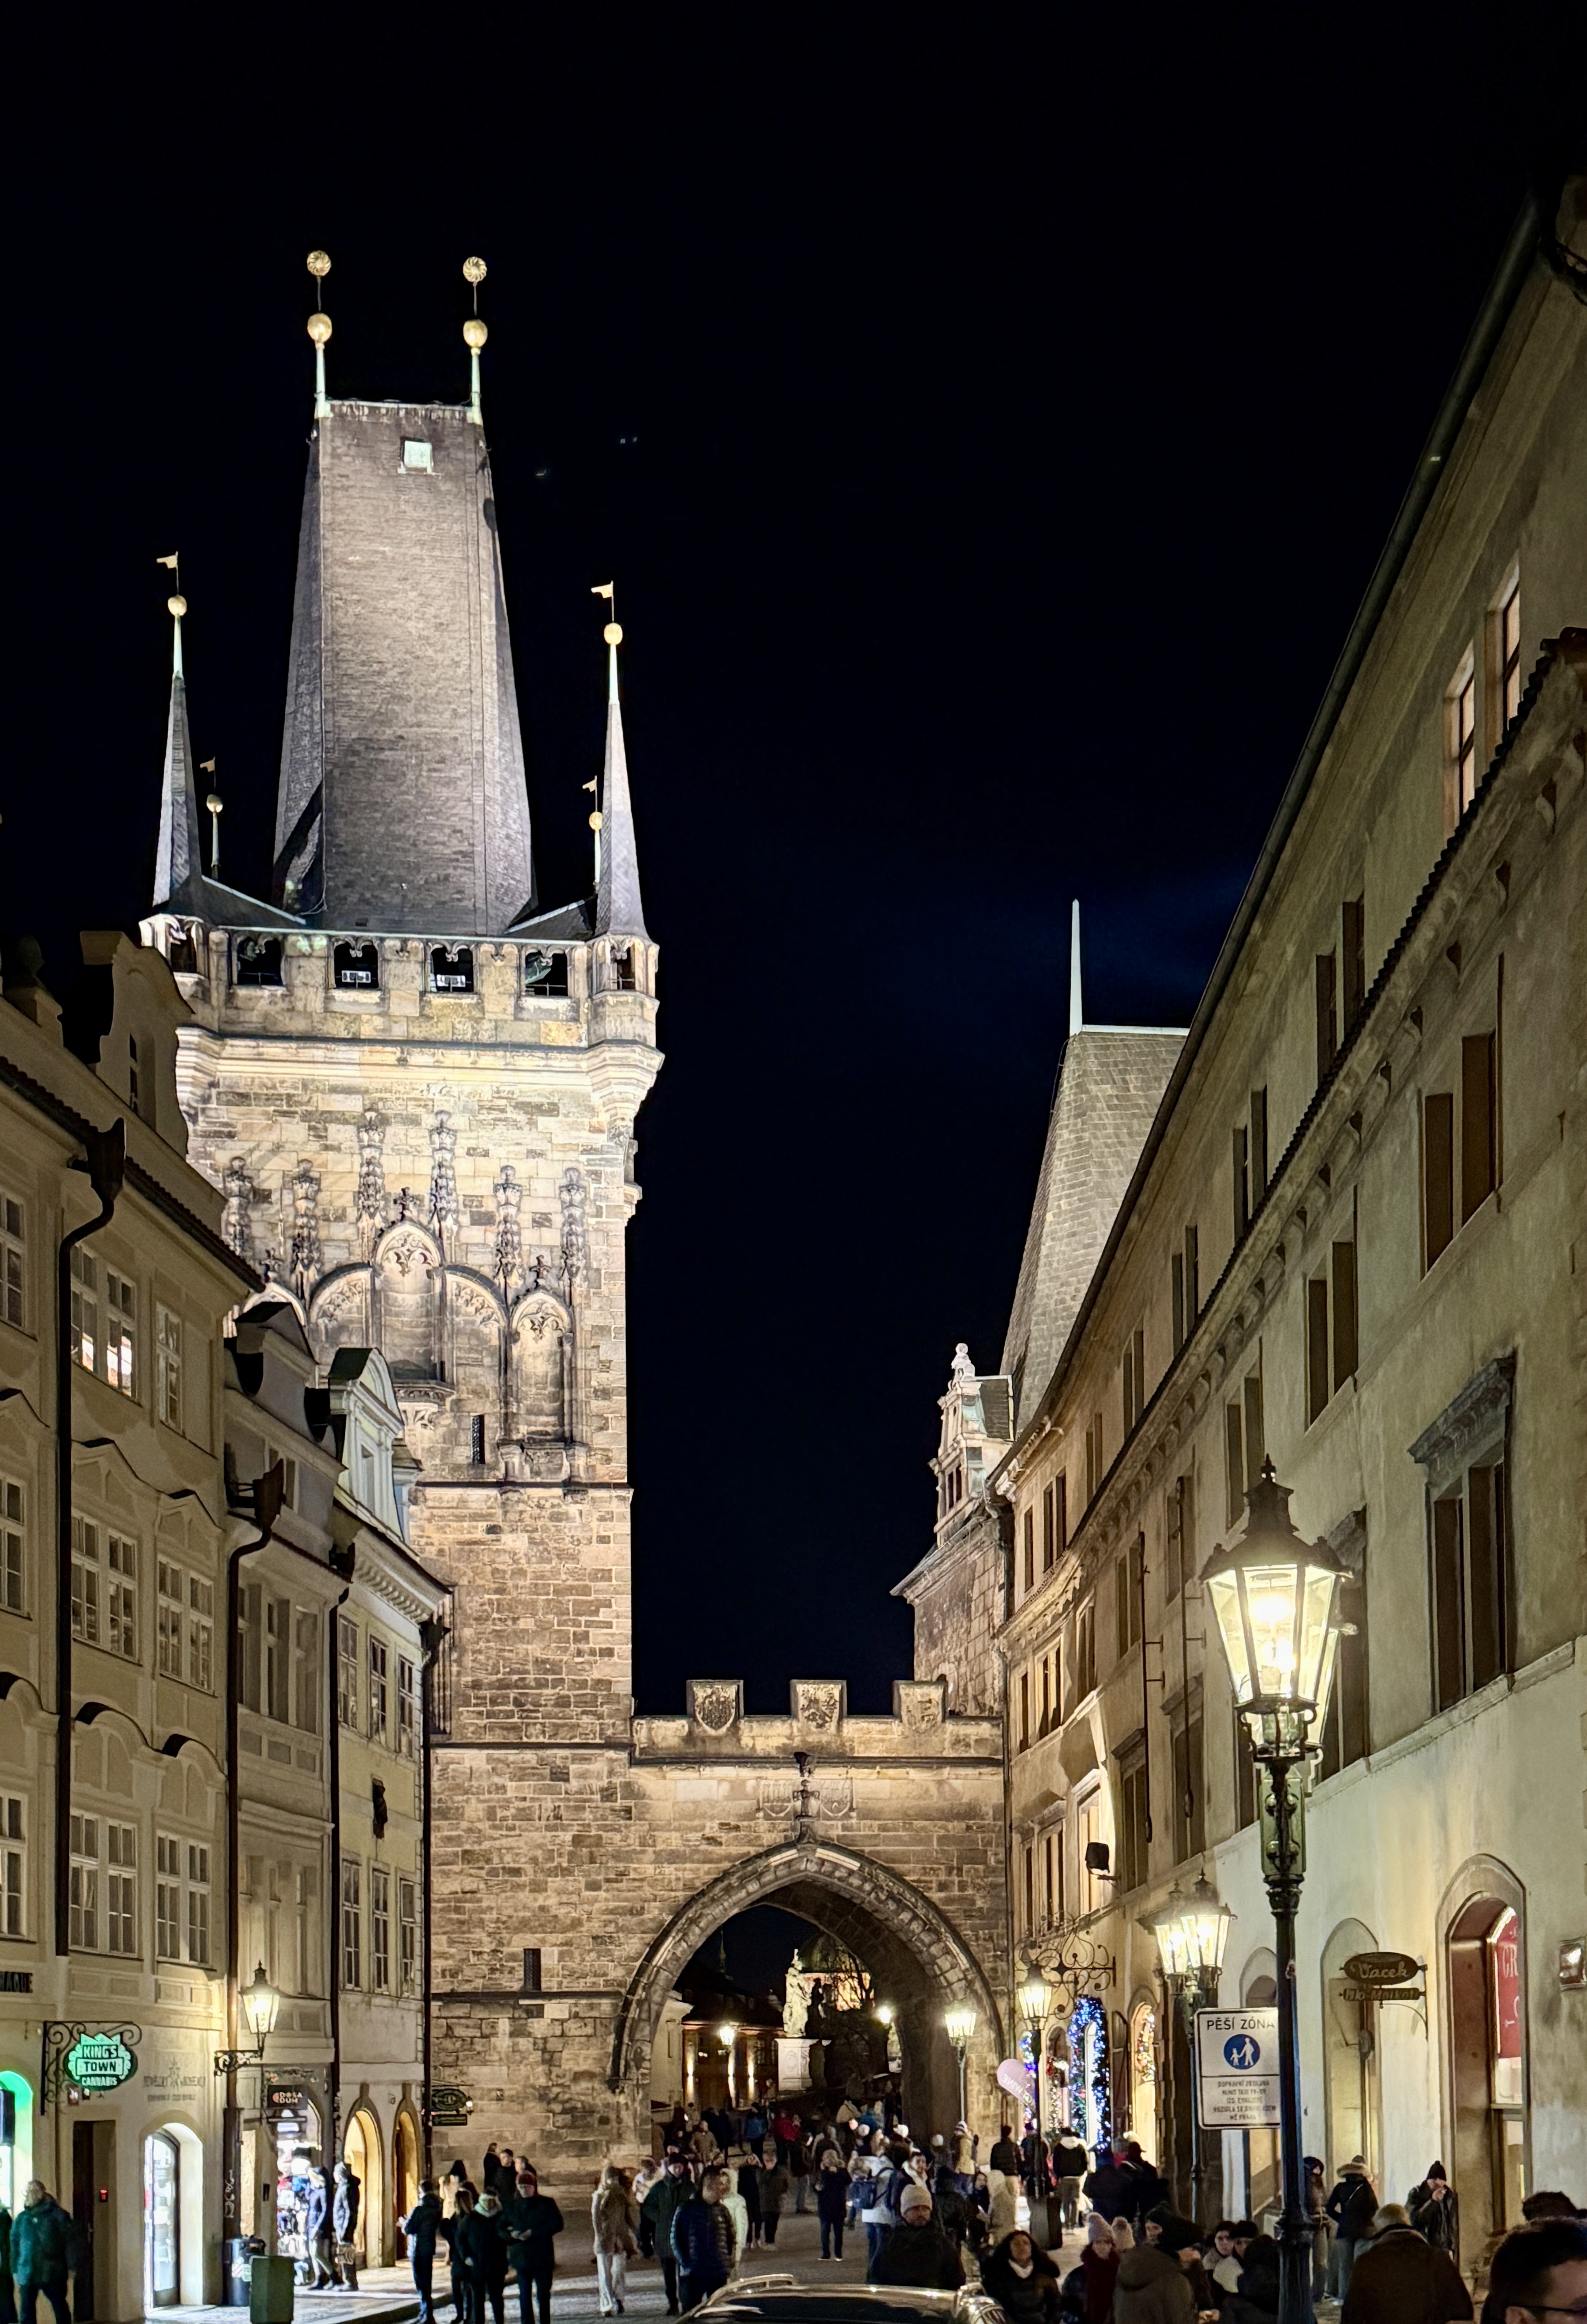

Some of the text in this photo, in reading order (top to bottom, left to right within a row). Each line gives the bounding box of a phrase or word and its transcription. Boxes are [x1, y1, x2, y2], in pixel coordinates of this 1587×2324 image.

[1350, 1961, 1408, 1979] Vacek
[1207, 2016, 1275, 2030] PĚŠÍ ZÓNA
[84, 2061, 116, 2072] TOWN
[82, 2076, 117, 2086] CANNABIS
